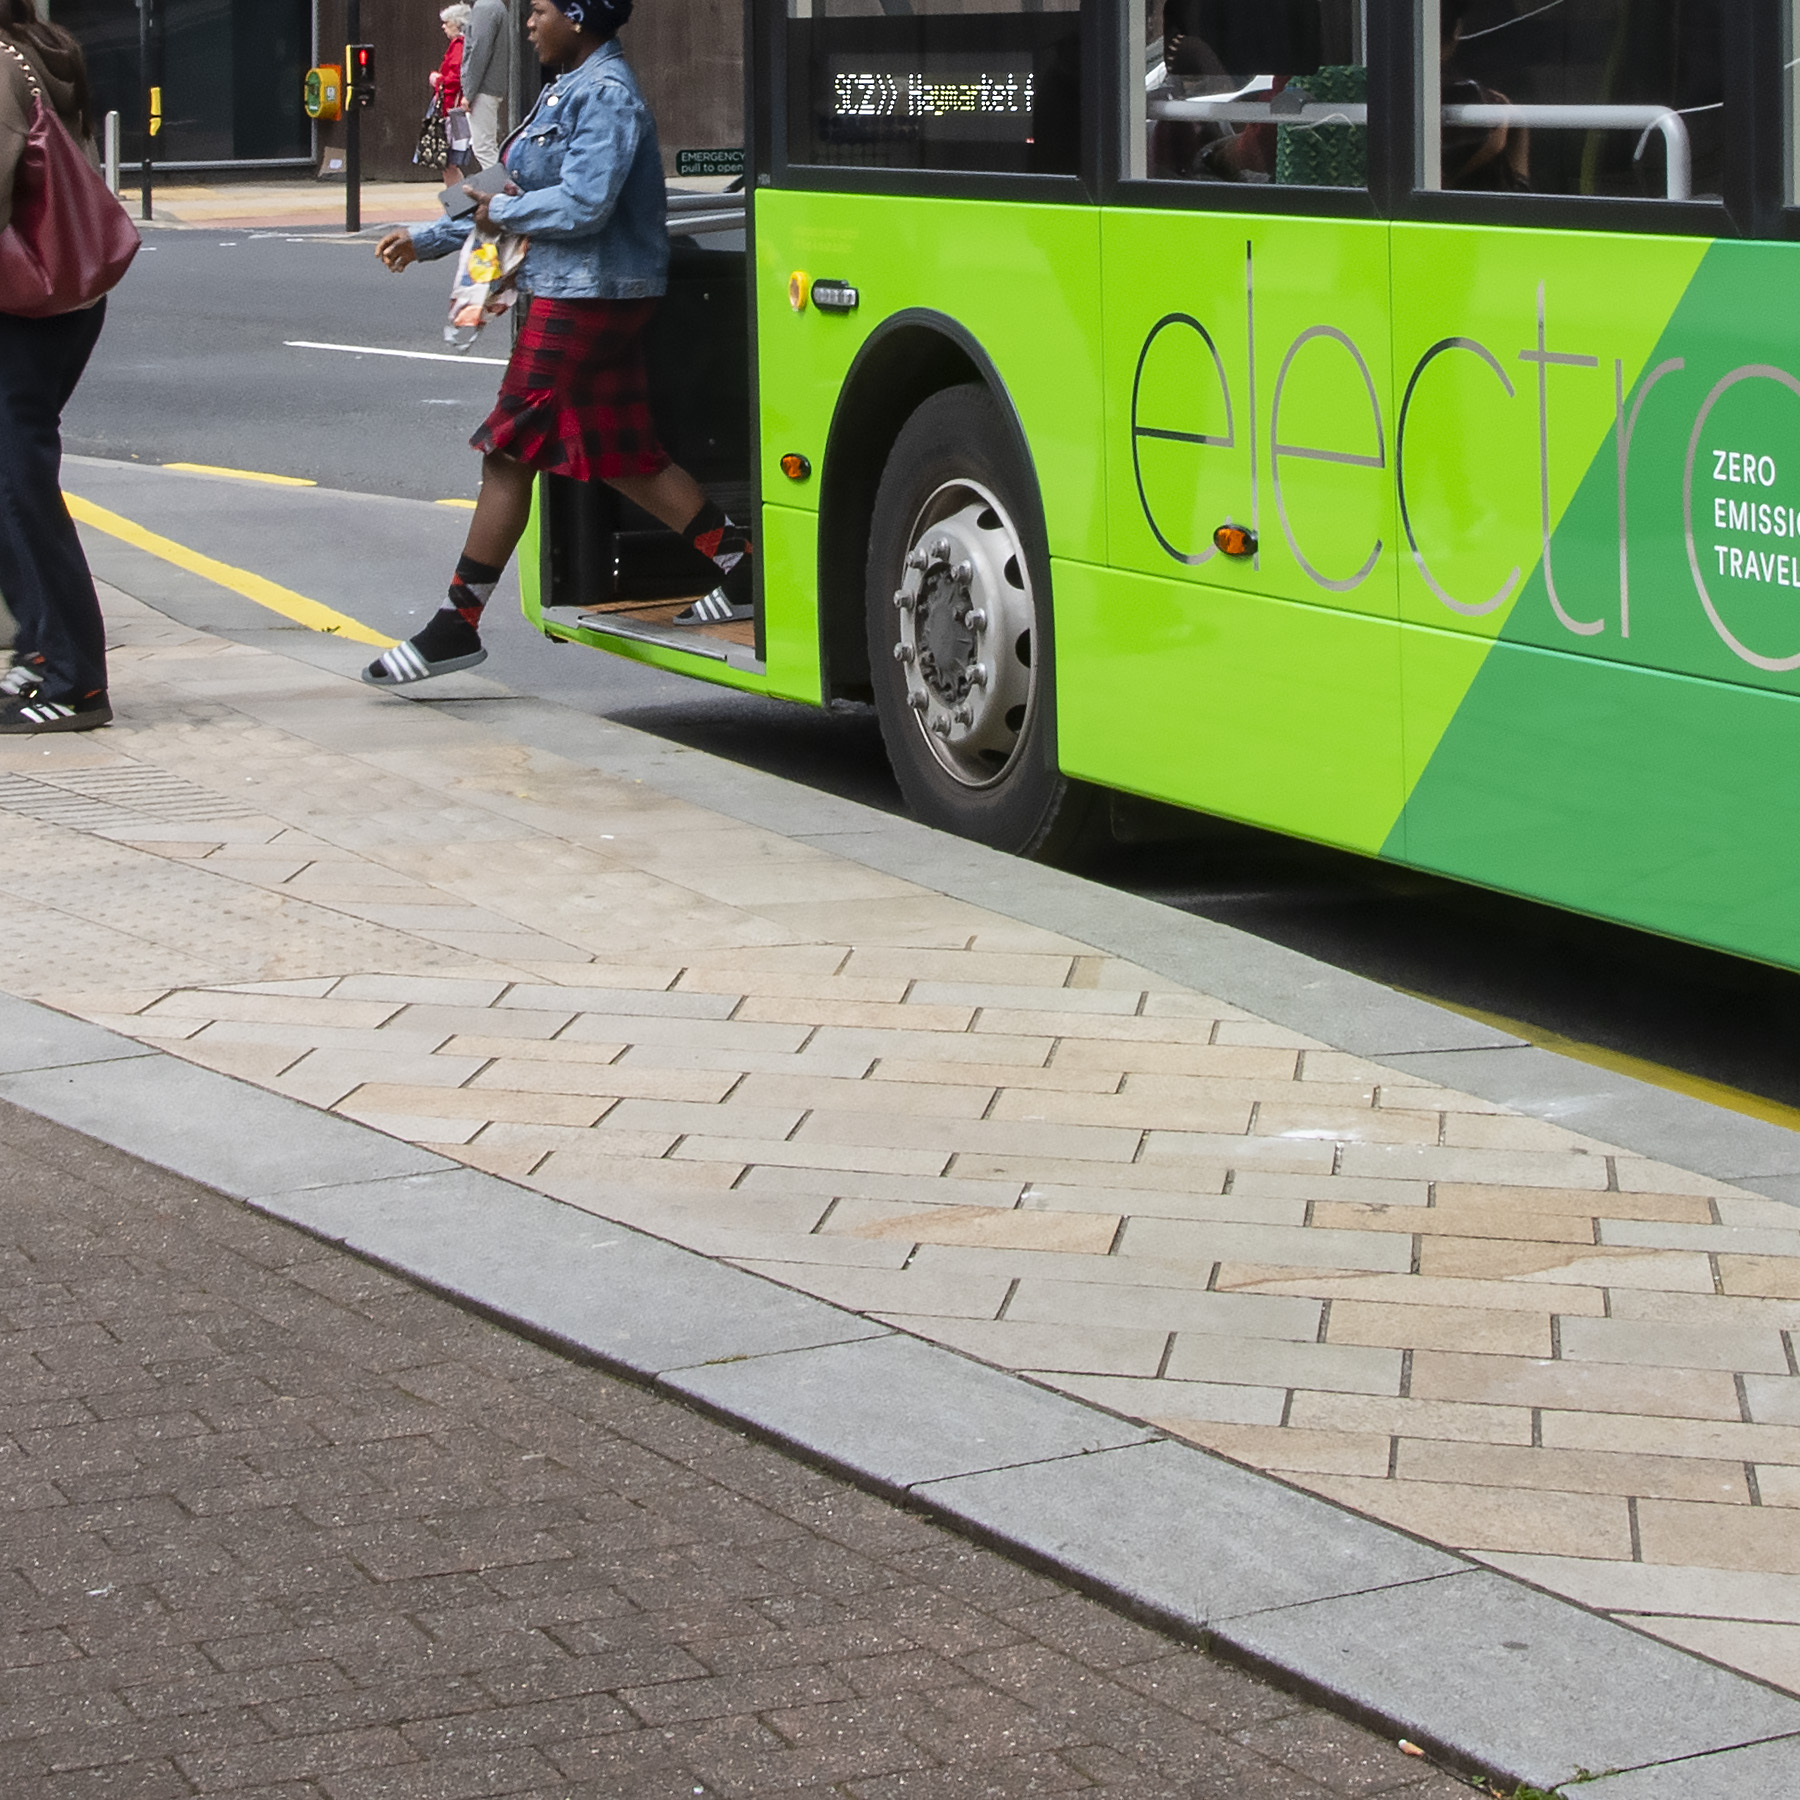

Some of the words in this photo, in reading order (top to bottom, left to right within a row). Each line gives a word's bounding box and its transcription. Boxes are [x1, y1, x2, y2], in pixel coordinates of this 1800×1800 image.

[680, 150, 746, 163] EMERGENCY
[680, 163, 701, 174] pull
[703, 164, 715, 173] to
[717, 164, 744, 174] open
[1712, 450, 1776, 487] ZERO
